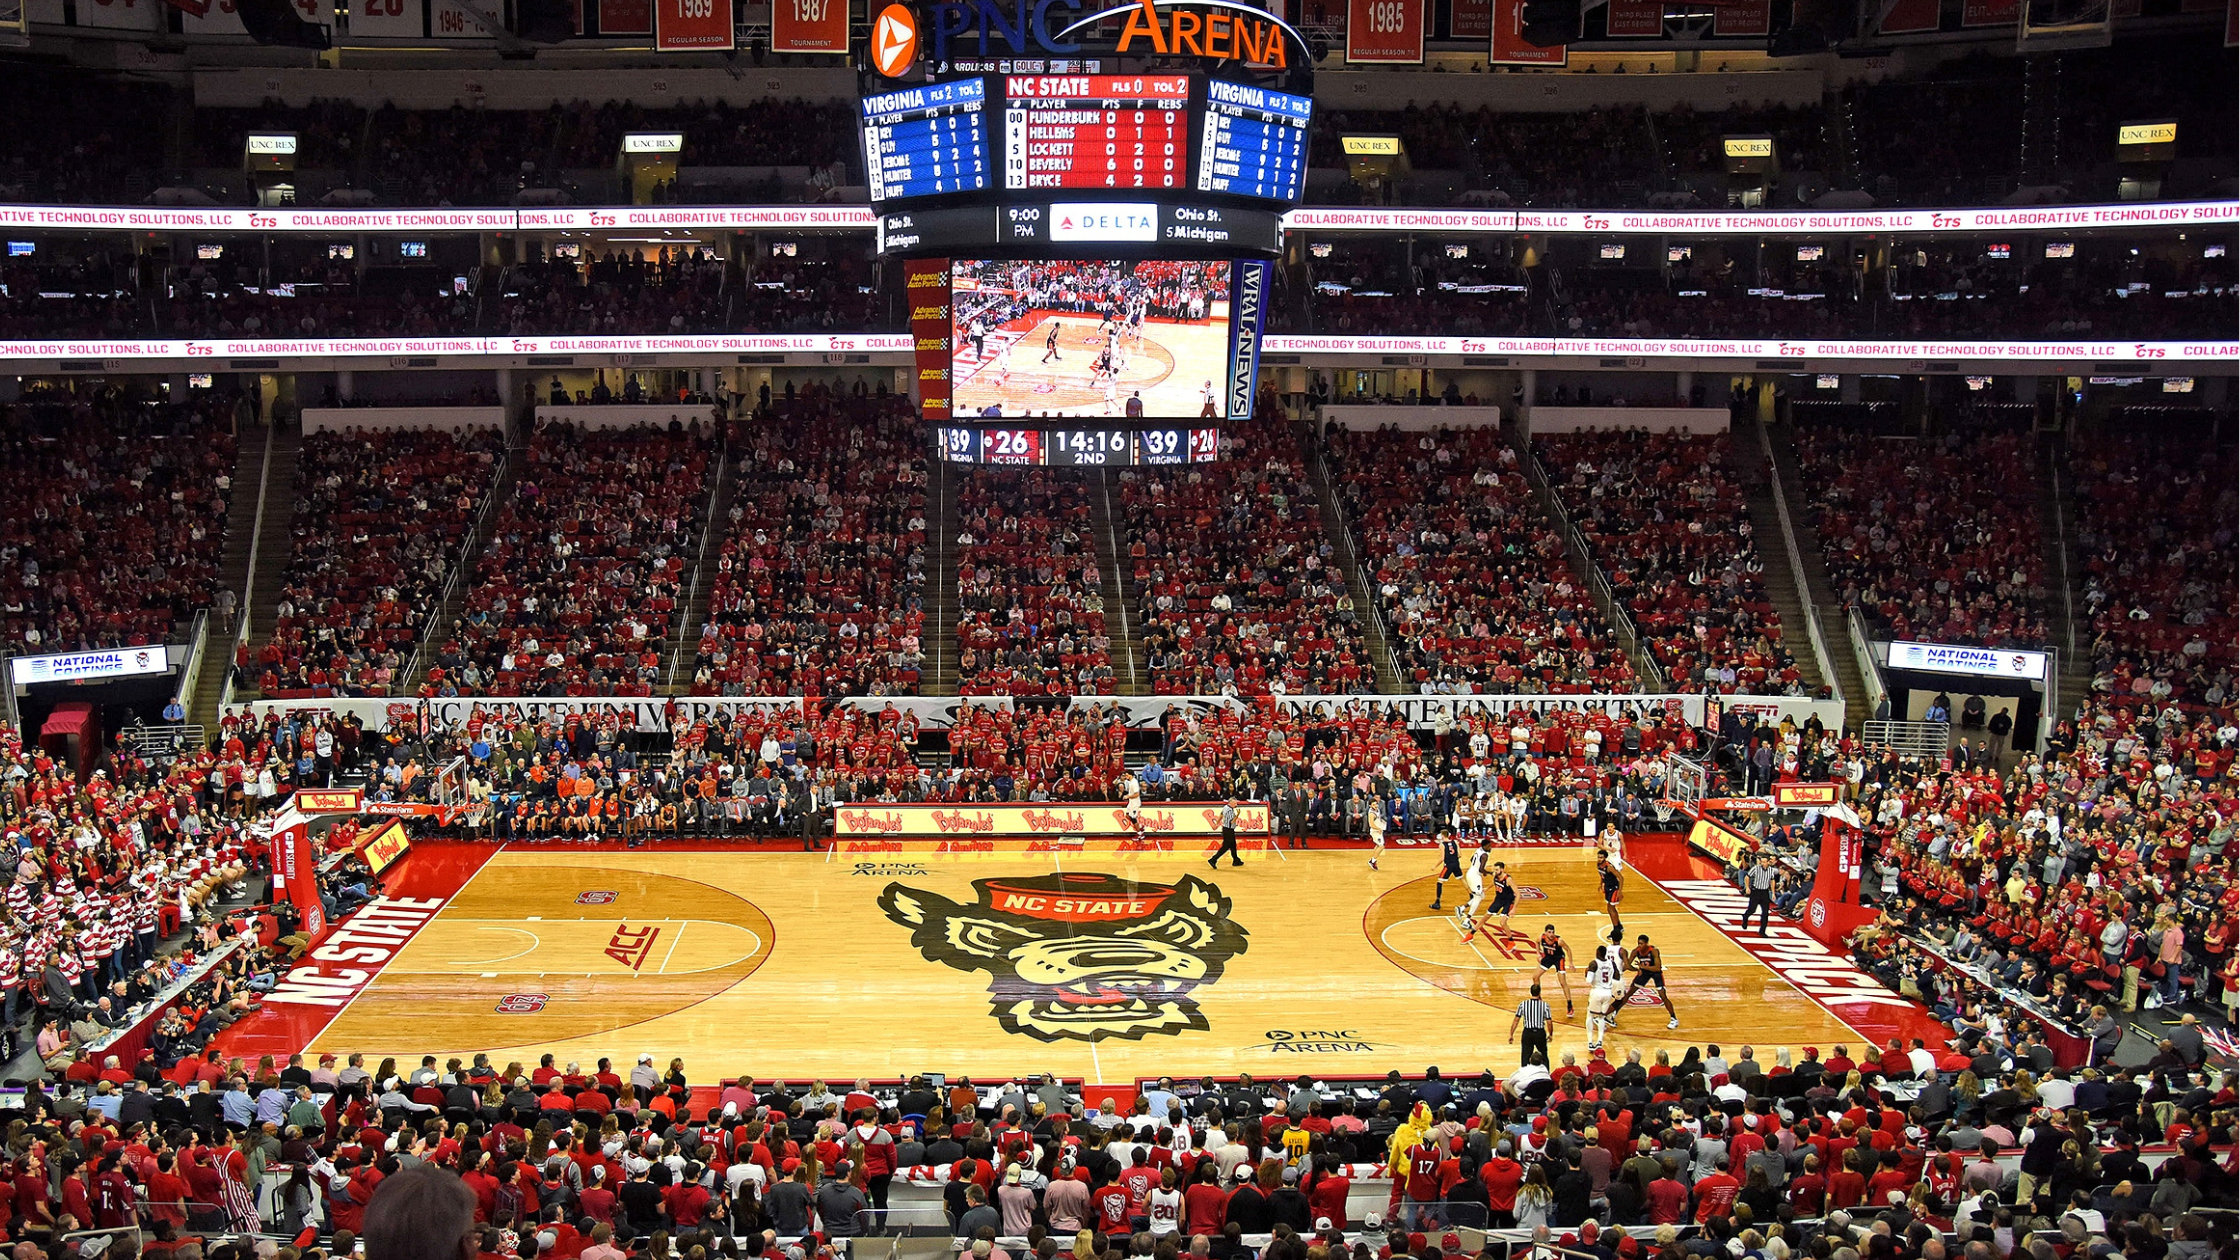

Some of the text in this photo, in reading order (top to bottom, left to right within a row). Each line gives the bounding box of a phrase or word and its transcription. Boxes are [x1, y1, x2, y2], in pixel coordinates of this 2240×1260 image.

[793, 0, 830, 22] 1987
[1368, 1, 1404, 33] 1985
[667, 36, 698, 44] REGULAR
[929, 0, 1287, 68] PNC ARENA
[790, 39, 832, 47] TOURNAMENT
[1009, 77, 1186, 96] NC STATE FLS 0 TOL 2
[1210, 80, 1264, 108] VIRGINIA
[863, 90, 925, 115] VIRGINIA
[1030, 99, 1183, 110] PLAYER PTS F REBS
[1009, 113, 1023, 123] 00
[1106, 111, 1117, 124] 0
[1134, 112, 1145, 124] 0
[1164, 112, 1175, 124] 0
[1012, 128, 1019, 138] 4
[1106, 127, 1116, 139] 0
[1136, 127, 1143, 139] 1
[1166, 127, 1173, 139] 1
[2121, 128, 2174, 140] UNC REX
[250, 140, 295, 149] UNC REX
[632, 139, 675, 148] UNC REX
[1012, 144, 1019, 155] 5
[1106, 143, 1116, 155] 0
[1134, 143, 1144, 155] 2
[1164, 143, 1174, 155] 0
[1349, 142, 1391, 150] UNC REX
[1725, 144, 1770, 153] UNC REX
[1009, 158, 1174, 171] 10 BEVERLY 6 0 0
[1009, 174, 1174, 187] 13 BRYCE 4 2 0
[40, 211, 125, 224] TECHNOLOGY
[130, 213, 203, 225] SOLUTIONS,
[210, 214, 231, 225] LLC
[254, 217, 277, 228] CTS
[293, 215, 391, 226] COLLABORATIVE
[397, 214, 472, 226] TECHNOLOGY
[554, 214, 573, 224] LLC
[593, 214, 615, 226] CTS
[630, 212, 724, 223] COLLABORATIVE
[731, 212, 806, 223] TECHNOLOGY
[1009, 208, 1040, 222] 9:00
[1175, 208, 1222, 223] Ohio St.
[1294, 214, 1467, 226] COLLABORATIVE TECHNOLOGY
[1936, 208, 2188, 228] CTS COLLABORATIVE TECHNOLOGY
[1083, 216, 1150, 229] DELTA
[1014, 225, 1035, 238] PM
[1174, 225, 1229, 242] Michigan
[911, 272, 938, 282] Advance
[228, 341, 471, 353] COLLABORATIVE TECHNOLOGY SOLUTIONS,
[1233, 267, 1261, 414] WRAL NEWS
[1465, 340, 1761, 354] CTS COLLABORATIVE TECHNOLOGY SOLUTIONS, LLC
[951, 429, 970, 453] 39
[995, 430, 1029, 454] 26
[1055, 430, 1126, 453] 14:16
[1148, 430, 1179, 454] 39
[1199, 430, 1214, 452] 26
[950, 453, 974, 464] VIRGINIA
[991, 455, 1030, 465] NC STATE
[1074, 453, 1106, 465] 2ND
[1147, 455, 1182, 465] VIRGINIA
[53, 654, 123, 667] NATIONAL
[1927, 648, 1998, 662] NATIONAL
[53, 663, 124, 676] COATINGS
[1926, 658, 1998, 671] COATINGS
[853, 867, 929, 876] ARENA
[881, 862, 925, 870] PNC
[1003, 894, 1147, 915] NC STATE
[260, 895, 445, 1006] NC STATE
[604, 923, 652, 967] ACC
[1657, 879, 1916, 1009] WOLFPACK
[1602, 971, 1609, 983] 5
[1299, 1030, 1362, 1040] PNC
[1271, 1042, 1374, 1053] ARENA
[1173, 1136, 1187, 1151] 18
[1288, 1144, 1303, 1158] 10
[1418, 1160, 1435, 1175] 17
[1154, 1203, 1175, 1220] 20
